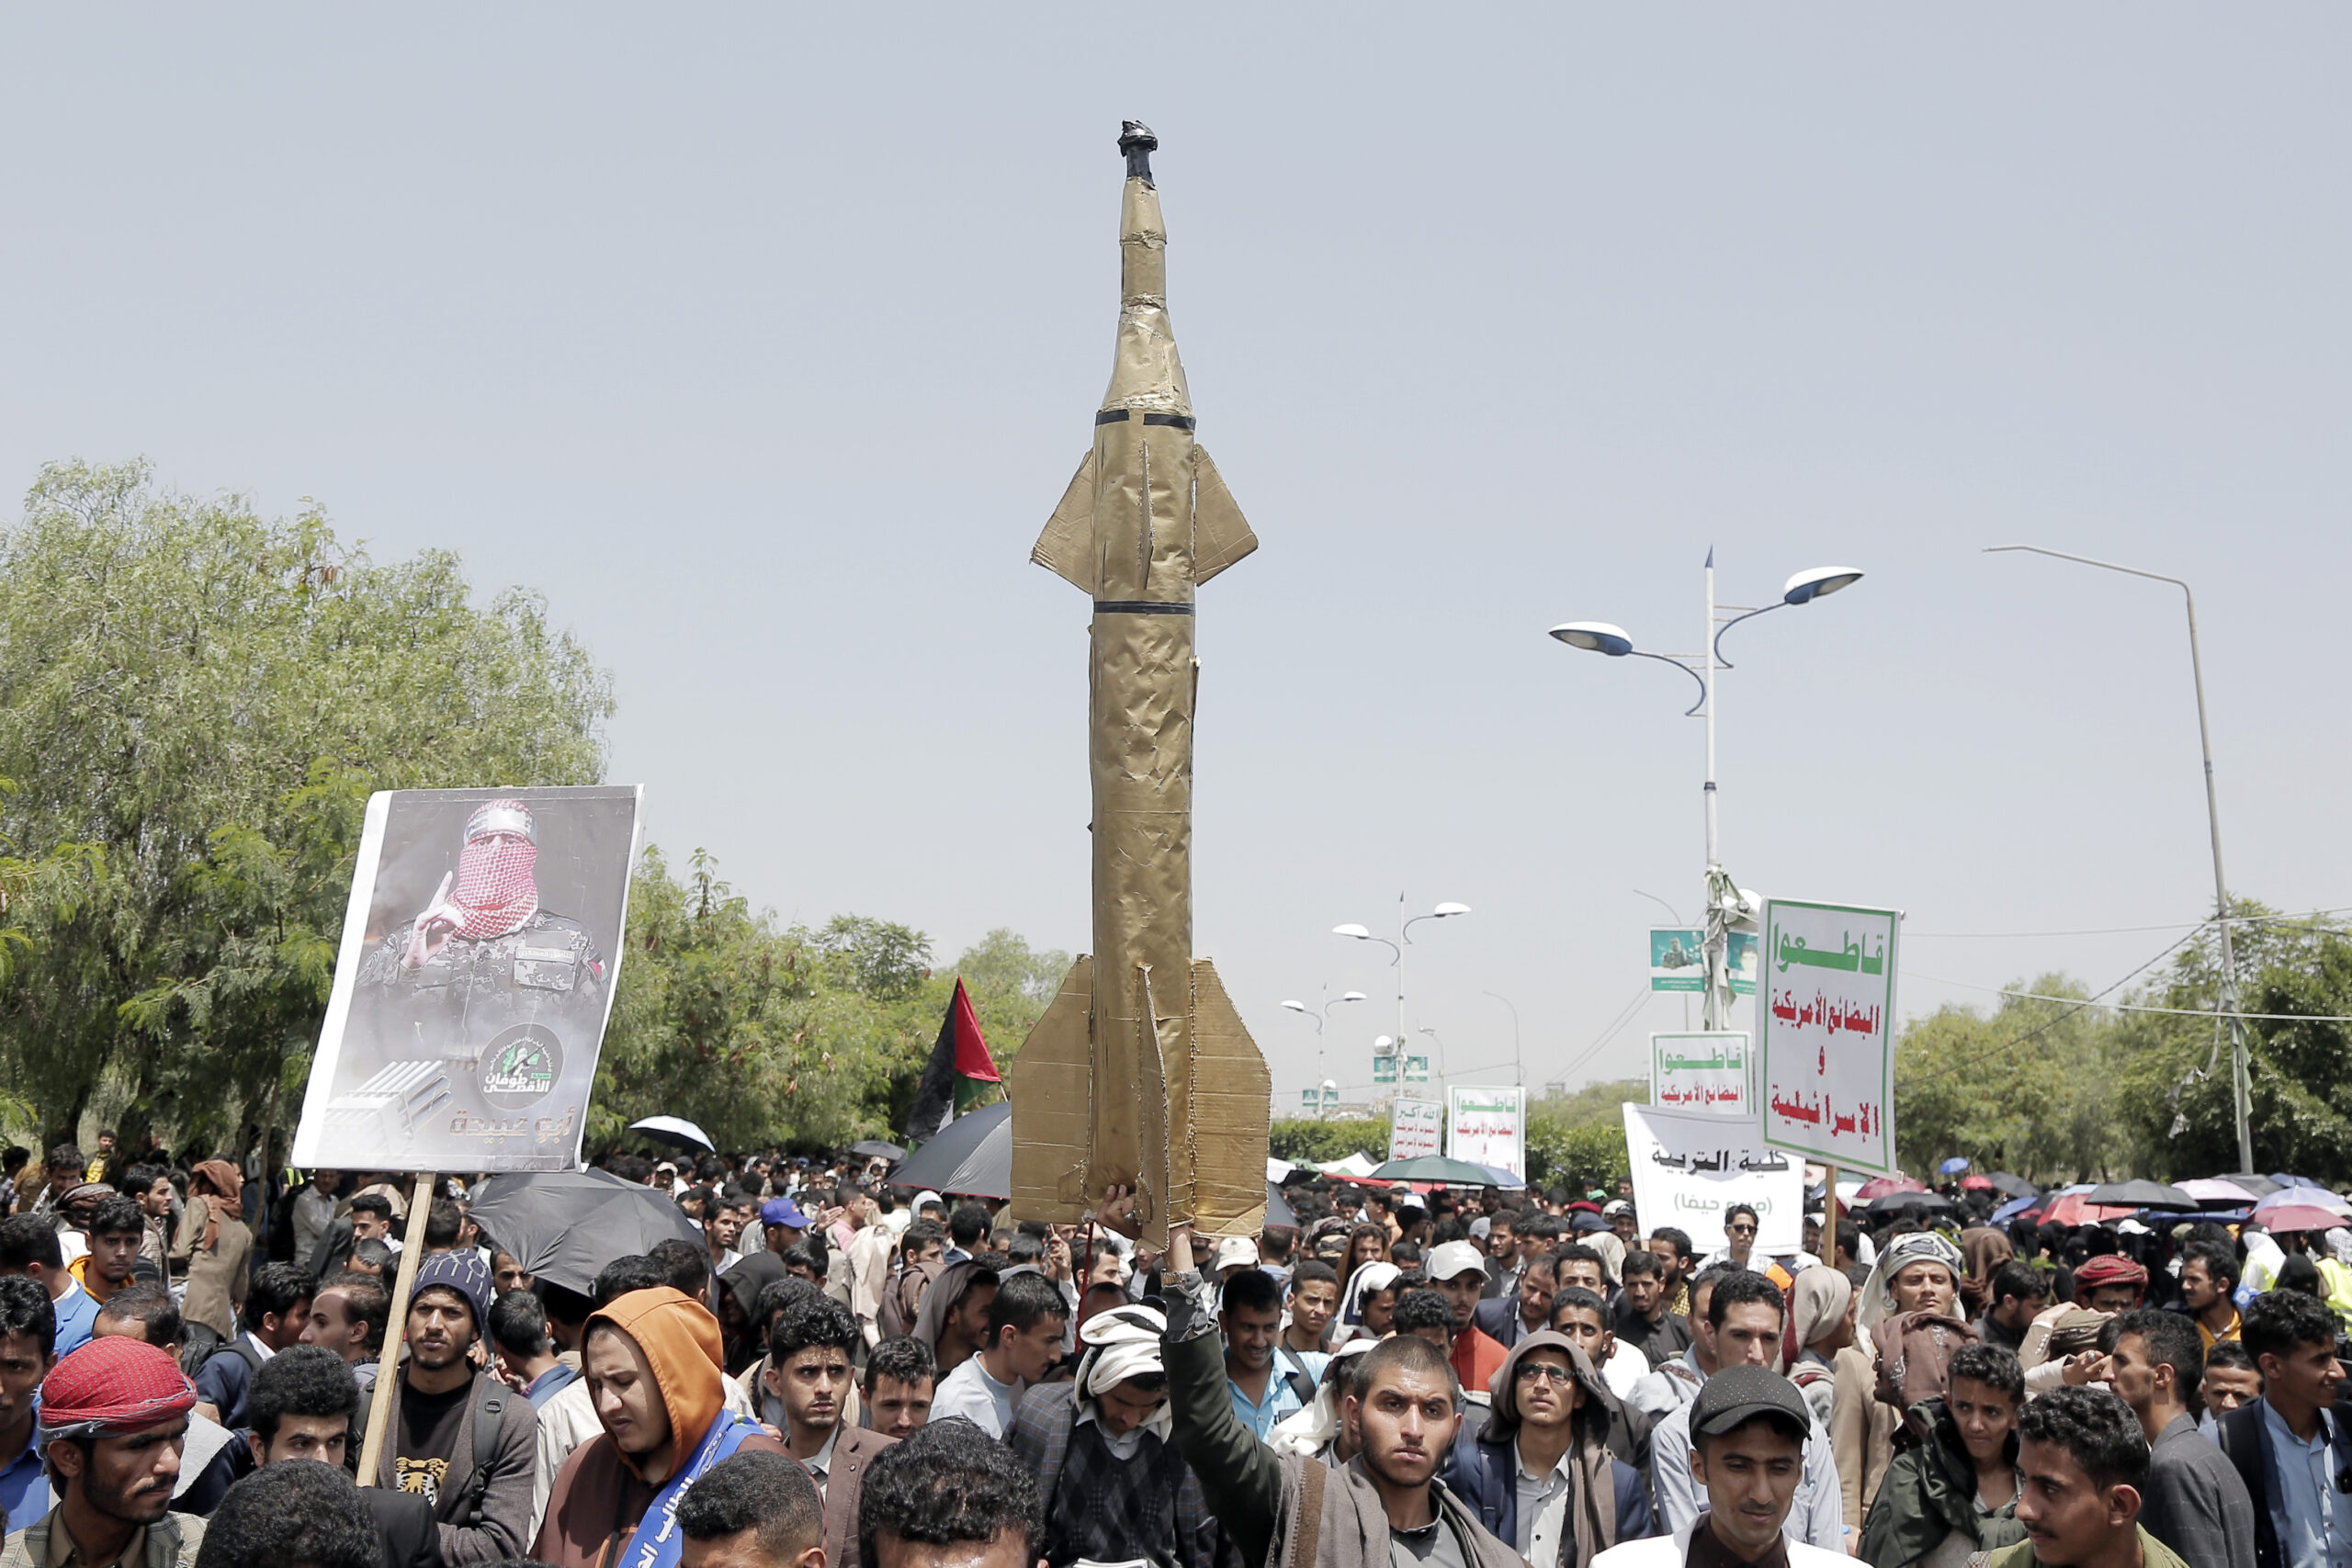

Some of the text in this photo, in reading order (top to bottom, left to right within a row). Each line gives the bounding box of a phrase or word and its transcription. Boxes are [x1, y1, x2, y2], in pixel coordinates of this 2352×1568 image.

[1773, 922, 1883, 976] قاطعوا
[1772, 988, 1880, 1040] البضائع الأمريكية
[1659, 1047, 1742, 1076] قاطعوا
[1817, 1045, 1826, 1076] و
[485, 1073, 528, 1088] طوفان
[1705, 1084, 1744, 1105] البضائع
[1456, 1095, 1516, 1115] قاطعوا
[1771, 1084, 1879, 1143] الإسرائيلية
[449, 1106, 575, 1144] أبو عبيدة
[1488, 1122, 1516, 1139] البضائع
[1652, 1141, 1729, 1175] التربية
[1674, 1193, 1720, 1214] حيفا)
